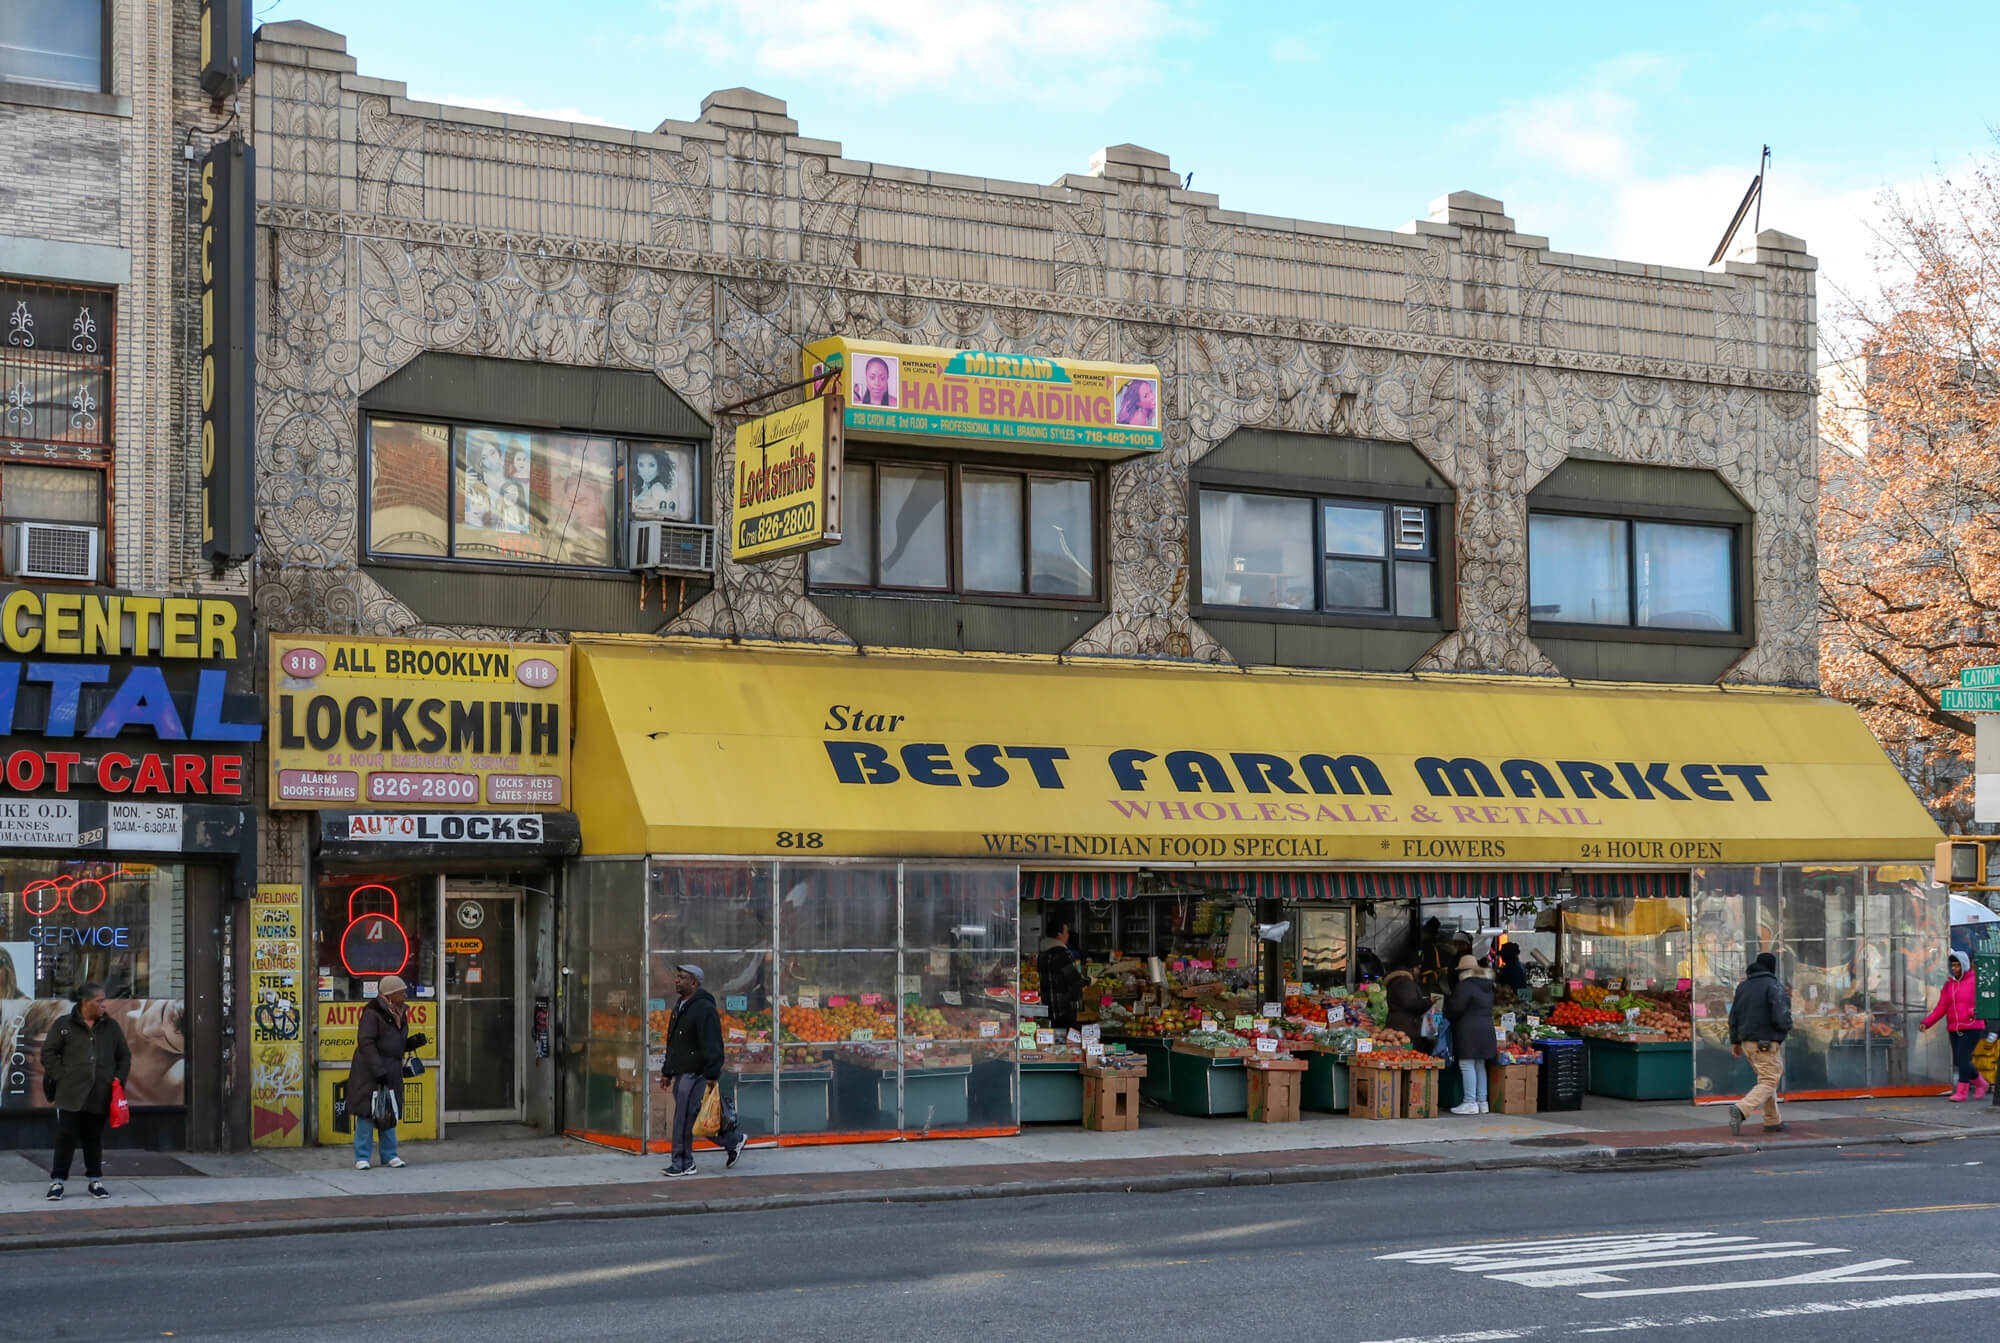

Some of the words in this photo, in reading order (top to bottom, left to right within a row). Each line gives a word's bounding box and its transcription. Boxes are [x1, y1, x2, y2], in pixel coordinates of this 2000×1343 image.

[201, 161, 214, 545] SCHOOL
[964, 353, 1052, 379] MIRIAM
[974, 378, 1044, 390] AFRICAN
[901, 380, 969, 413] HAIR
[979, 387, 1112, 424] BRAIDING
[770, 413, 810, 440] Brooklyn
[940, 420, 991, 434] PROFESSIONAL
[1002, 424, 1015, 436] ALL
[1017, 425, 1048, 438] BRAIDING
[1050, 428, 1075, 440] STYLES
[739, 441, 816, 508] Locksmiths
[758, 504, 813, 543] 826-2800
[2, 590, 238, 659] CENTER
[290, 656, 317, 670] 818
[333, 648, 376, 673] ALL
[386, 650, 509, 677] BROOKLYN
[525, 666, 549, 680] 818
[1964, 669, 1994, 686] CATON
[1946, 691, 1993, 708] FLATBUSH
[280, 694, 559, 755] LOCKSMITH
[824, 705, 905, 733] Star
[328, 754, 342, 767] 24
[350, 754, 384, 767] HOUR
[392, 755, 464, 769] EMERGENCY
[472, 757, 520, 769] SERVICE
[823, 741, 1070, 789] BEST
[1108, 749, 1392, 796] FARM
[1414, 757, 1772, 801] MARKET
[0, 750, 80, 792] OT
[98, 752, 242, 795] CARE
[300, 773, 337, 784] ALARMS
[373, 777, 474, 797] 826-2800
[495, 778, 523, 788] LOCKS
[530, 779, 553, 788] KEYS
[38, 804, 71, 818] O.D.
[113, 806, 141, 818] MON.
[156, 808, 178, 819] SAT.
[1107, 800, 1398, 823] WHOLESALE
[1411, 804, 1443, 824] &
[1452, 806, 1602, 825] RETAIL
[79, 829, 102, 844] 820
[351, 816, 415, 835] AUTO
[417, 817, 541, 841] LOCKS
[775, 831, 824, 849] 818
[982, 833, 1152, 856] WEST-INDIAN
[1159, 836, 1226, 857] FOOD
[1233, 837, 1329, 857] SPECIAL
[1402, 838, 1506, 858] FLOWERS
[1581, 845, 1602, 858] 24
[1607, 841, 1664, 859] HOUR
[1670, 842, 1723, 860] OPEN
[256, 892, 298, 904] WELDING
[29, 925, 129, 947] SERVICE
[257, 925, 296, 937] WORKS
